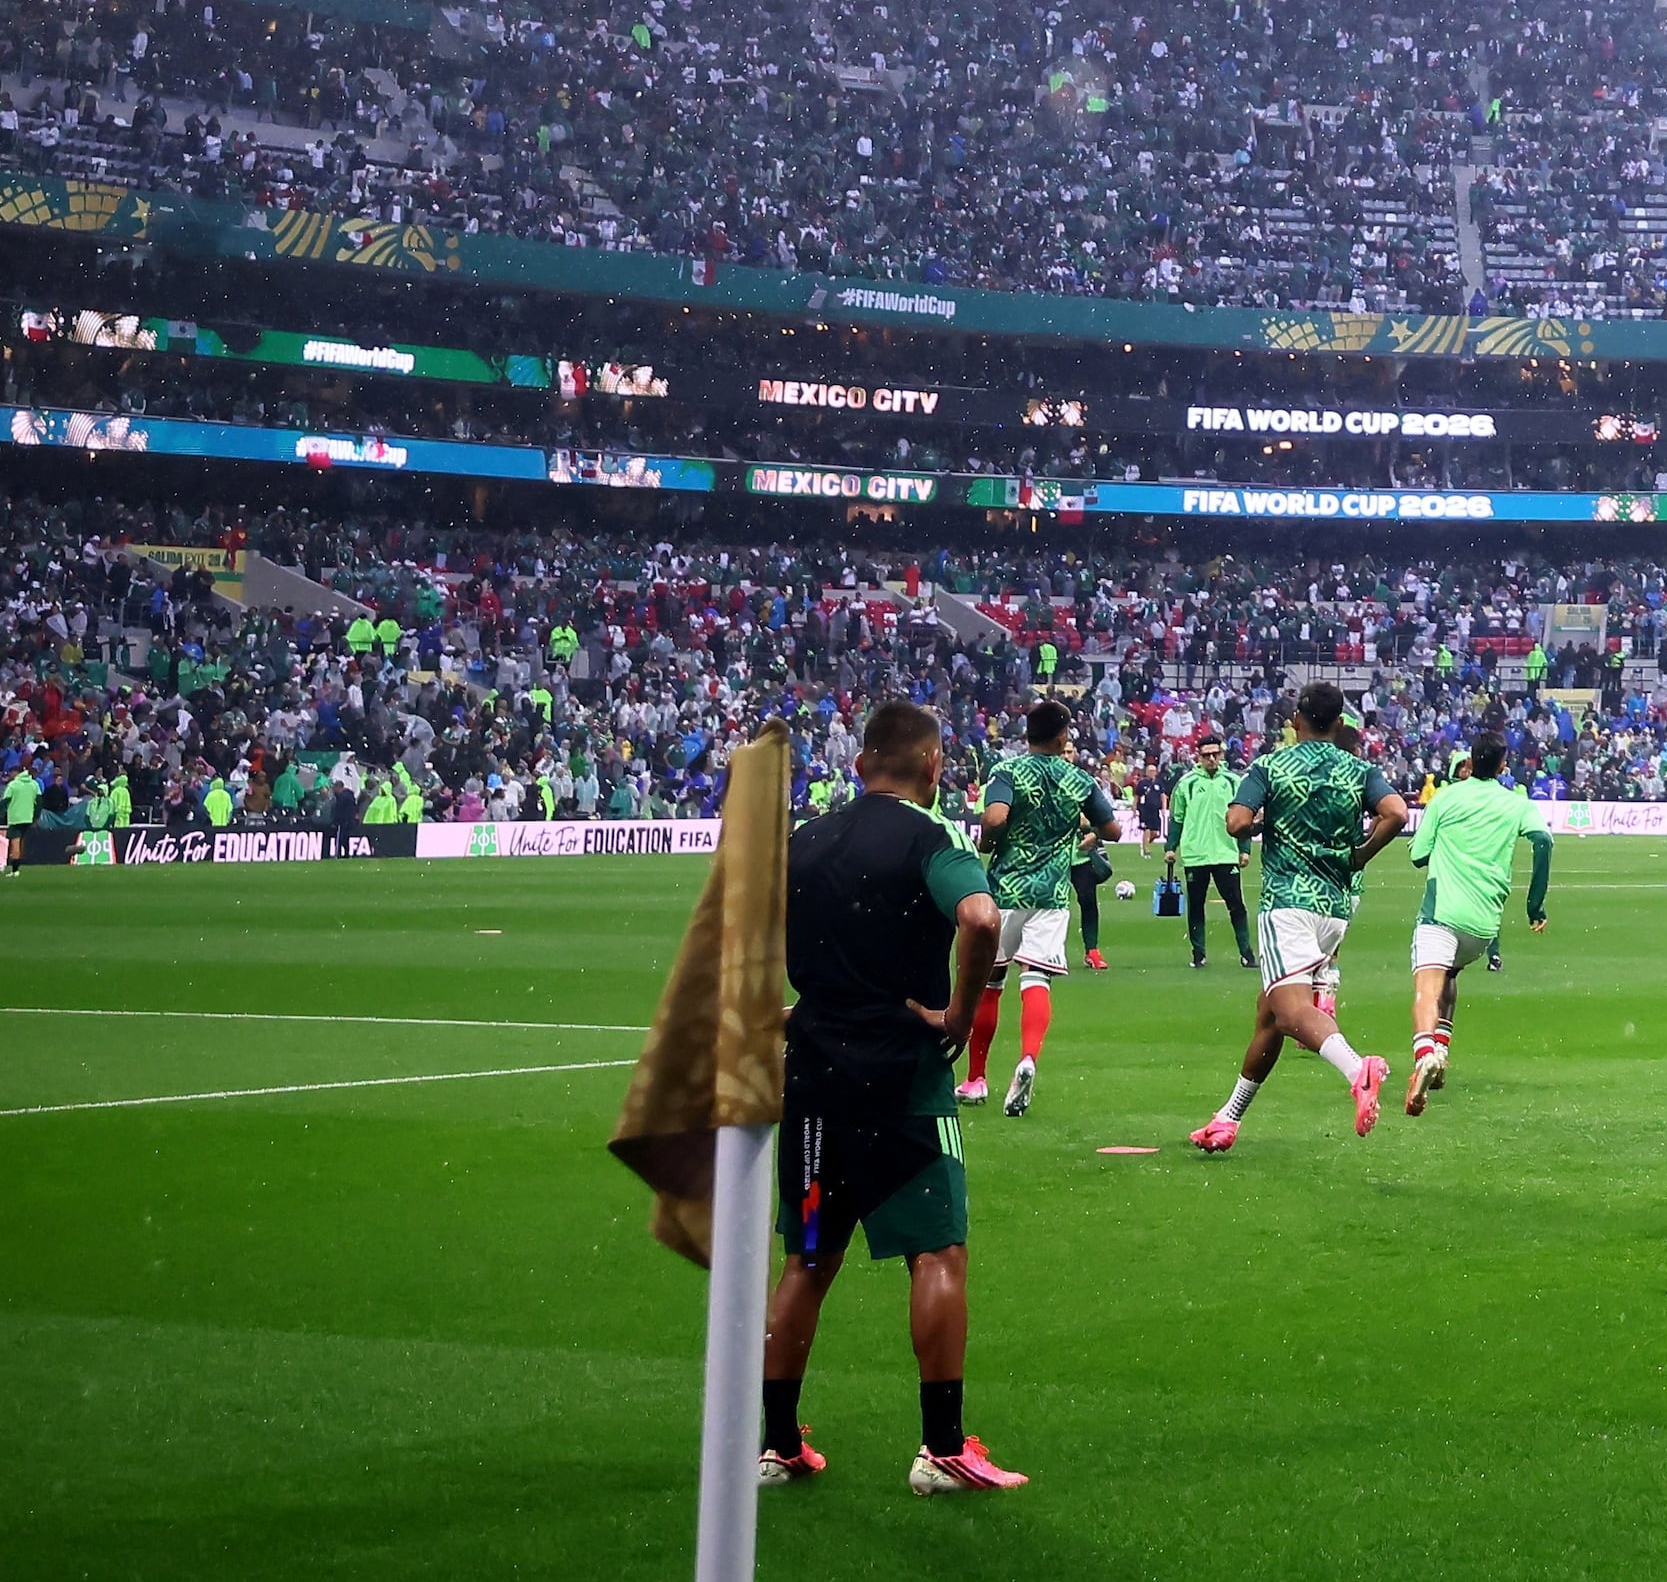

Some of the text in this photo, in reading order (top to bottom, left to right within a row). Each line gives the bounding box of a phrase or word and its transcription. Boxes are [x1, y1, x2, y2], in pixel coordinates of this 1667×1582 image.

[837, 287, 957, 318] #FIFAWorldCup
[302, 340, 415, 374] #FIFAWorldCup
[758, 379, 940, 416] MEXICO CITY
[1187, 406, 1496, 437] FIFA WORLD CUP 2026
[752, 468, 934, 503] MEXICO CITY
[1183, 489, 1493, 519] FIFA WORLD CUP 2026
[1601, 805, 1640, 830] Unite
[1643, 805, 1665, 829] For
[125, 830, 179, 865] Unite
[181, 830, 213, 864] For
[214, 831, 323, 864] EDUCATION
[509, 825, 713, 856] Unite For EDUCATION FIFA
